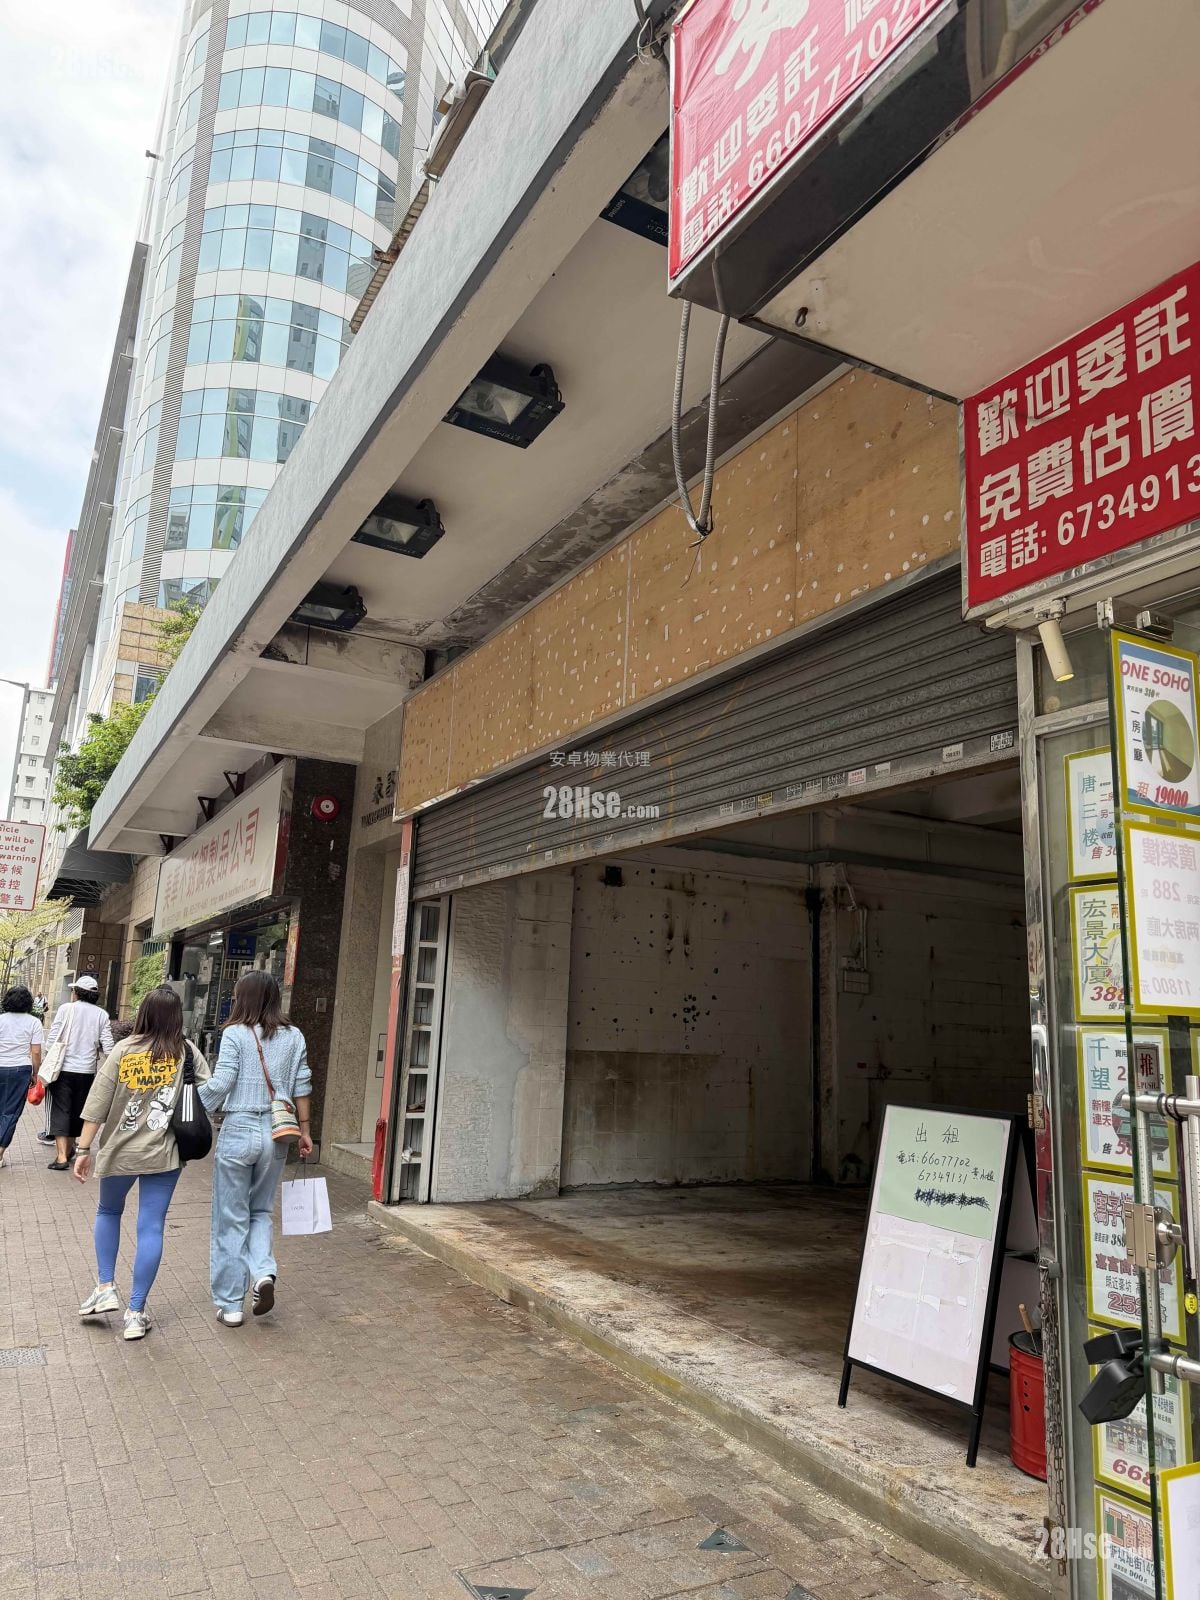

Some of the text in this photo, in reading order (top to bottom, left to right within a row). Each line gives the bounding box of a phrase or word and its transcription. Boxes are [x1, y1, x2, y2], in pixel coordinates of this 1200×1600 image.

[682, 24, 820, 213] 歡迎委託
[748, 0, 932, 188] 66077702
[977, 285, 1192, 457] 歡迎委託
[979, 374, 1195, 533] 免費估價
[980, 520, 1048, 578] 電話:
[1120, 660, 1190, 693] ONE SOHO
[1130, 710, 1144, 762] 一房一廳
[1154, 785, 1189, 809] 19000
[5, 835, 35, 845] will be
[1082, 899, 1112, 985] 宏景大廈
[122, 1064, 173, 1079] I'M NOT
[137, 1074, 166, 1086] MAD!
[1089, 1037, 1112, 1091] 千望
[1140, 1053, 1154, 1078] 推
